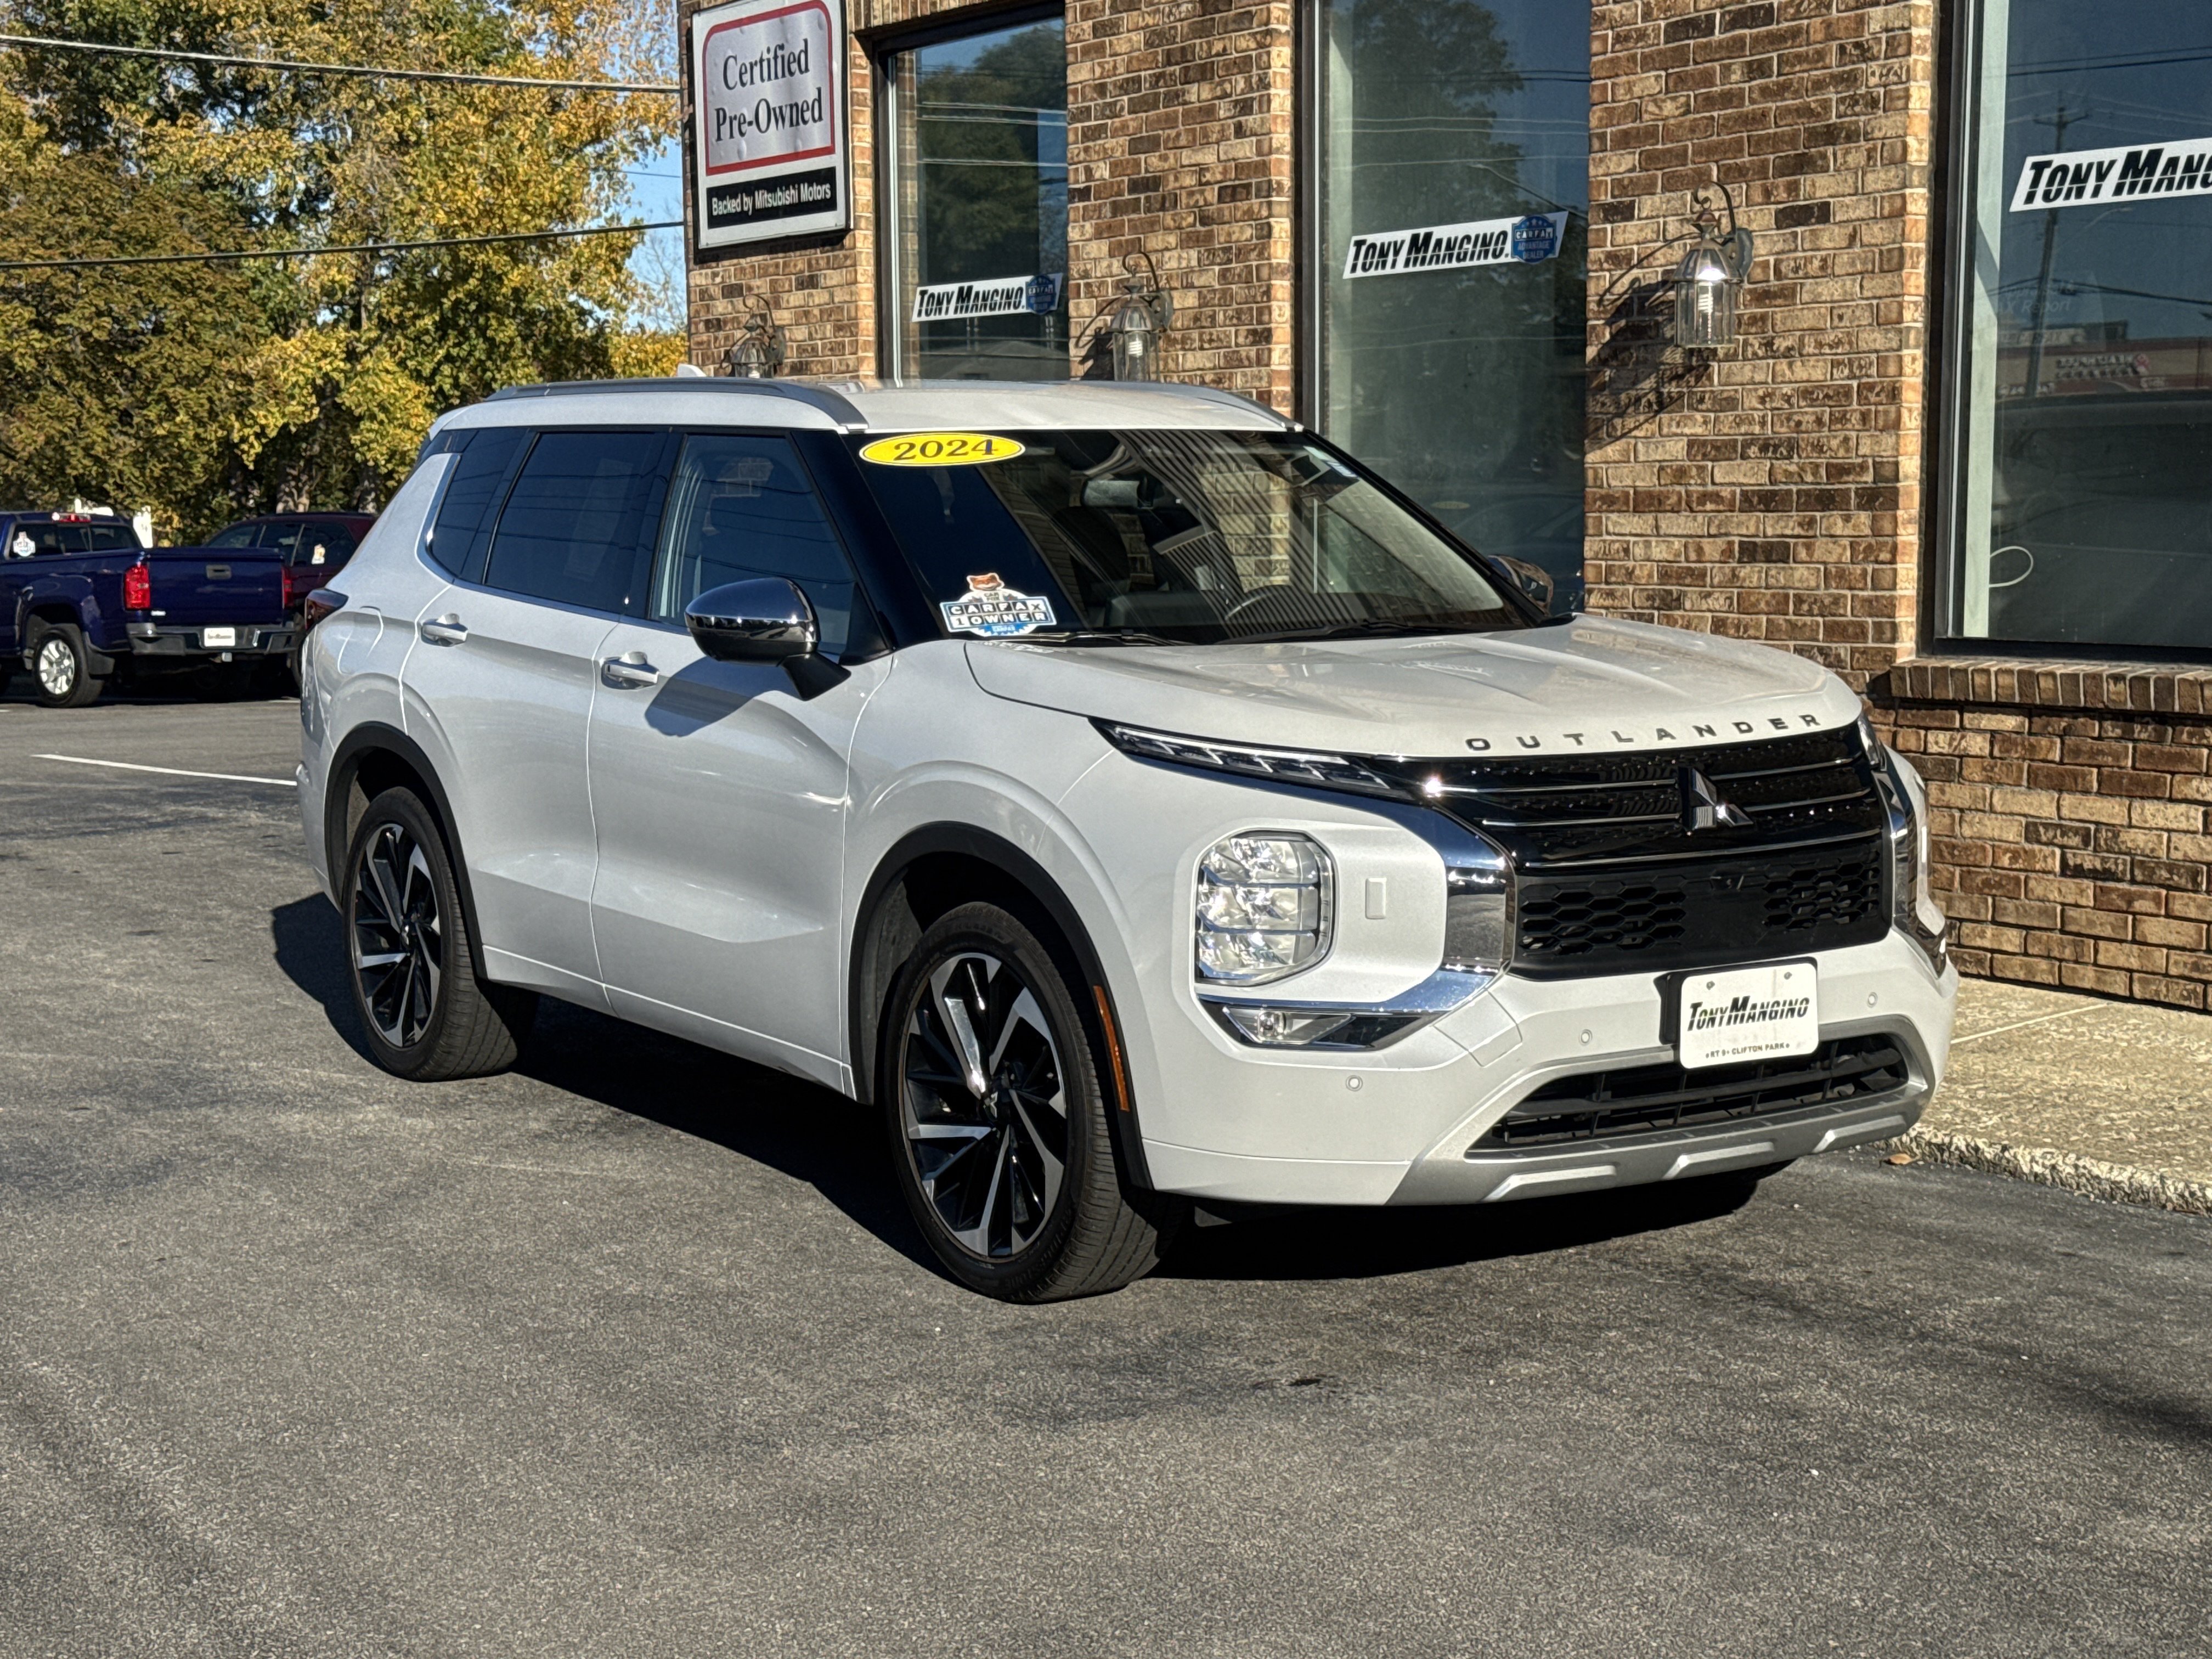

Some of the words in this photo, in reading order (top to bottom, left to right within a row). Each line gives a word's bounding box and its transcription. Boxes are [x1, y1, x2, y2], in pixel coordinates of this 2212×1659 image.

[723, 38, 810, 90] Certified
[714, 87, 823, 142] Pre-Owned
[712, 194, 741, 216] Backed
[743, 193, 753, 216] by
[755, 184, 798, 210] Mitsubishi
[800, 182, 831, 202] Motors
[2023, 159, 2117, 205] TONY
[1350, 238, 1405, 274] TONY
[917, 289, 955, 318] TONY
[893, 439, 1000, 461] 2024
[950, 602, 1042, 615] CARFAX
[1465, 713, 1821, 751] OUTLANDER
[1687, 1002, 1729, 1031] TONY
[1726, 995, 1809, 1026] MANGINO
[1732, 1045, 1763, 1055] CLIFTON
[1765, 1043, 1785, 1051] PARK
